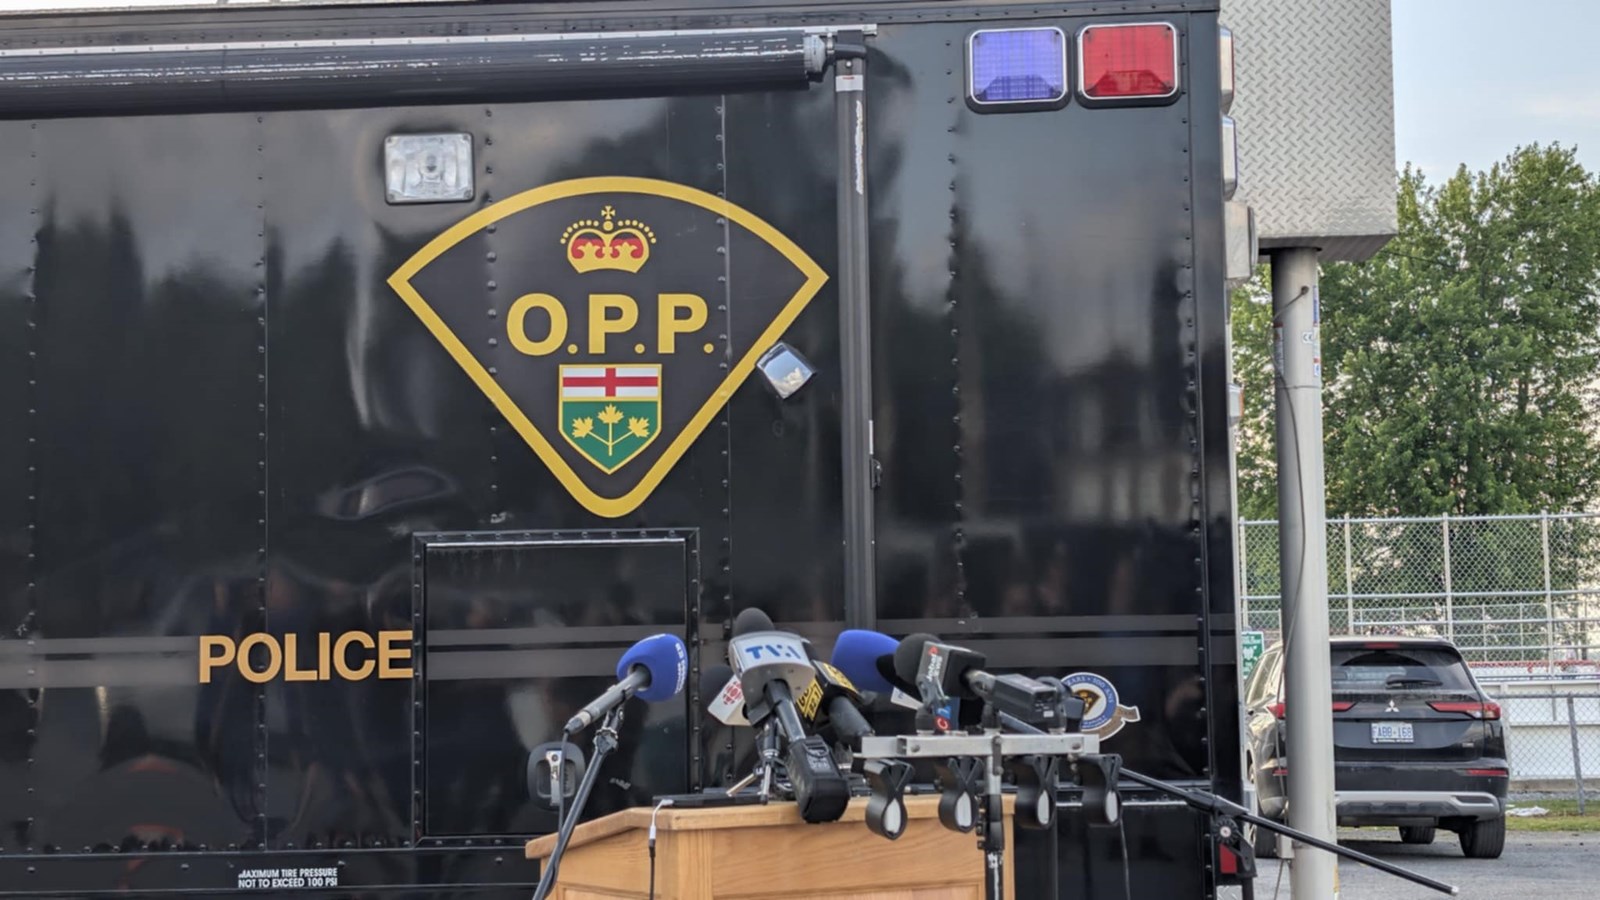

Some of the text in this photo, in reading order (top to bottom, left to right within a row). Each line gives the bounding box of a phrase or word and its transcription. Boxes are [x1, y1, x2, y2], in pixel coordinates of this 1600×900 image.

[506, 292, 714, 356] O.P.P.
[199, 630, 414, 684] POLICE
[238, 867, 338, 879] MAXIMUM TIRE PRESSURE
[238, 877, 338, 888] NOT TO EXCEED 100 PSI
